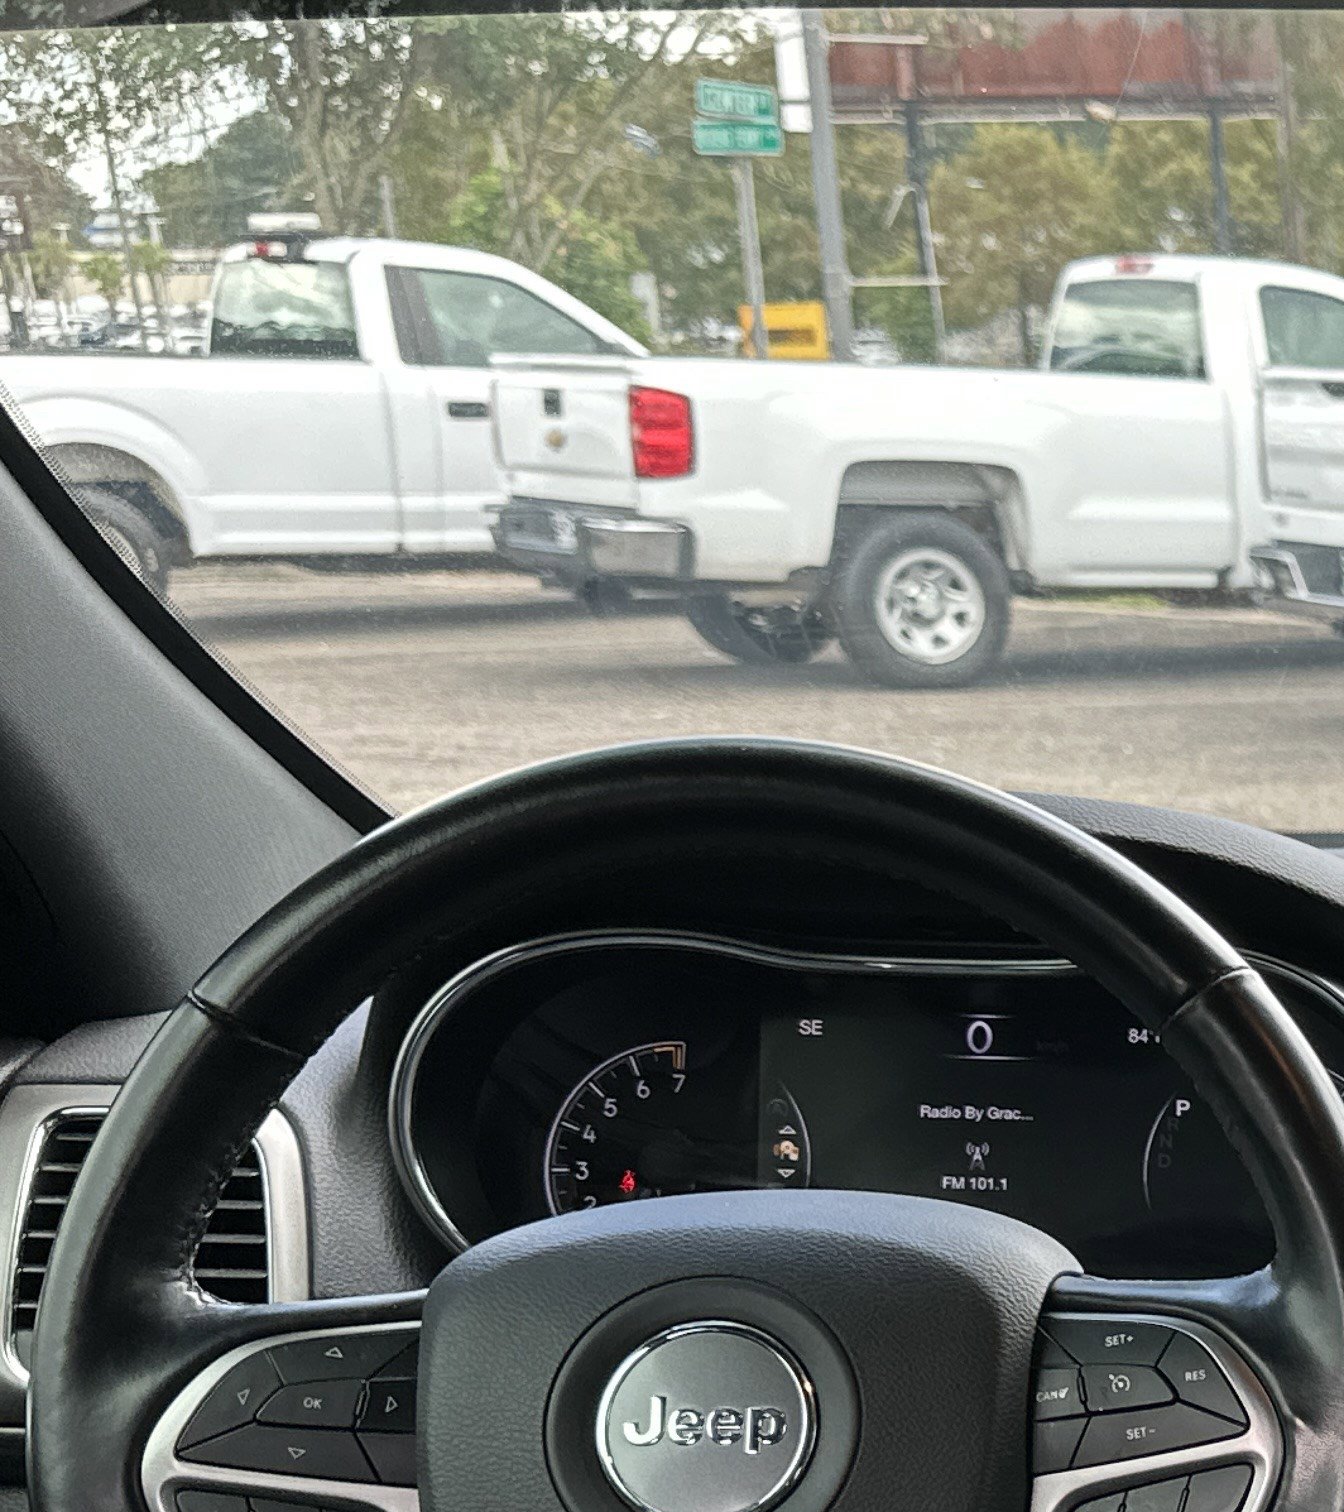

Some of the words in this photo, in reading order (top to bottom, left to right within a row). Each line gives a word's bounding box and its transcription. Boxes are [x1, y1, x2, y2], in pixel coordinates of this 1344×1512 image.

[799, 1019, 824, 1036] SE
[966, 1020, 994, 1054] 0
[636, 1079, 651, 1099] 6
[671, 1073, 686, 1094] 7
[602, 1098, 618, 1118] 5
[919, 1104, 962, 1119] Radio
[964, 1104, 984, 1122] By
[1175, 1099, 1191, 1117] P
[582, 1124, 597, 1144] 4
[575, 1160, 590, 1181] 3
[941, 1175, 966, 1190] FM
[968, 1176, 1008, 1191] 101.1
[1185, 1369, 1206, 1382] RES
[303, 1396, 323, 1409] OK
[622, 1395, 788, 1456] Jeep
